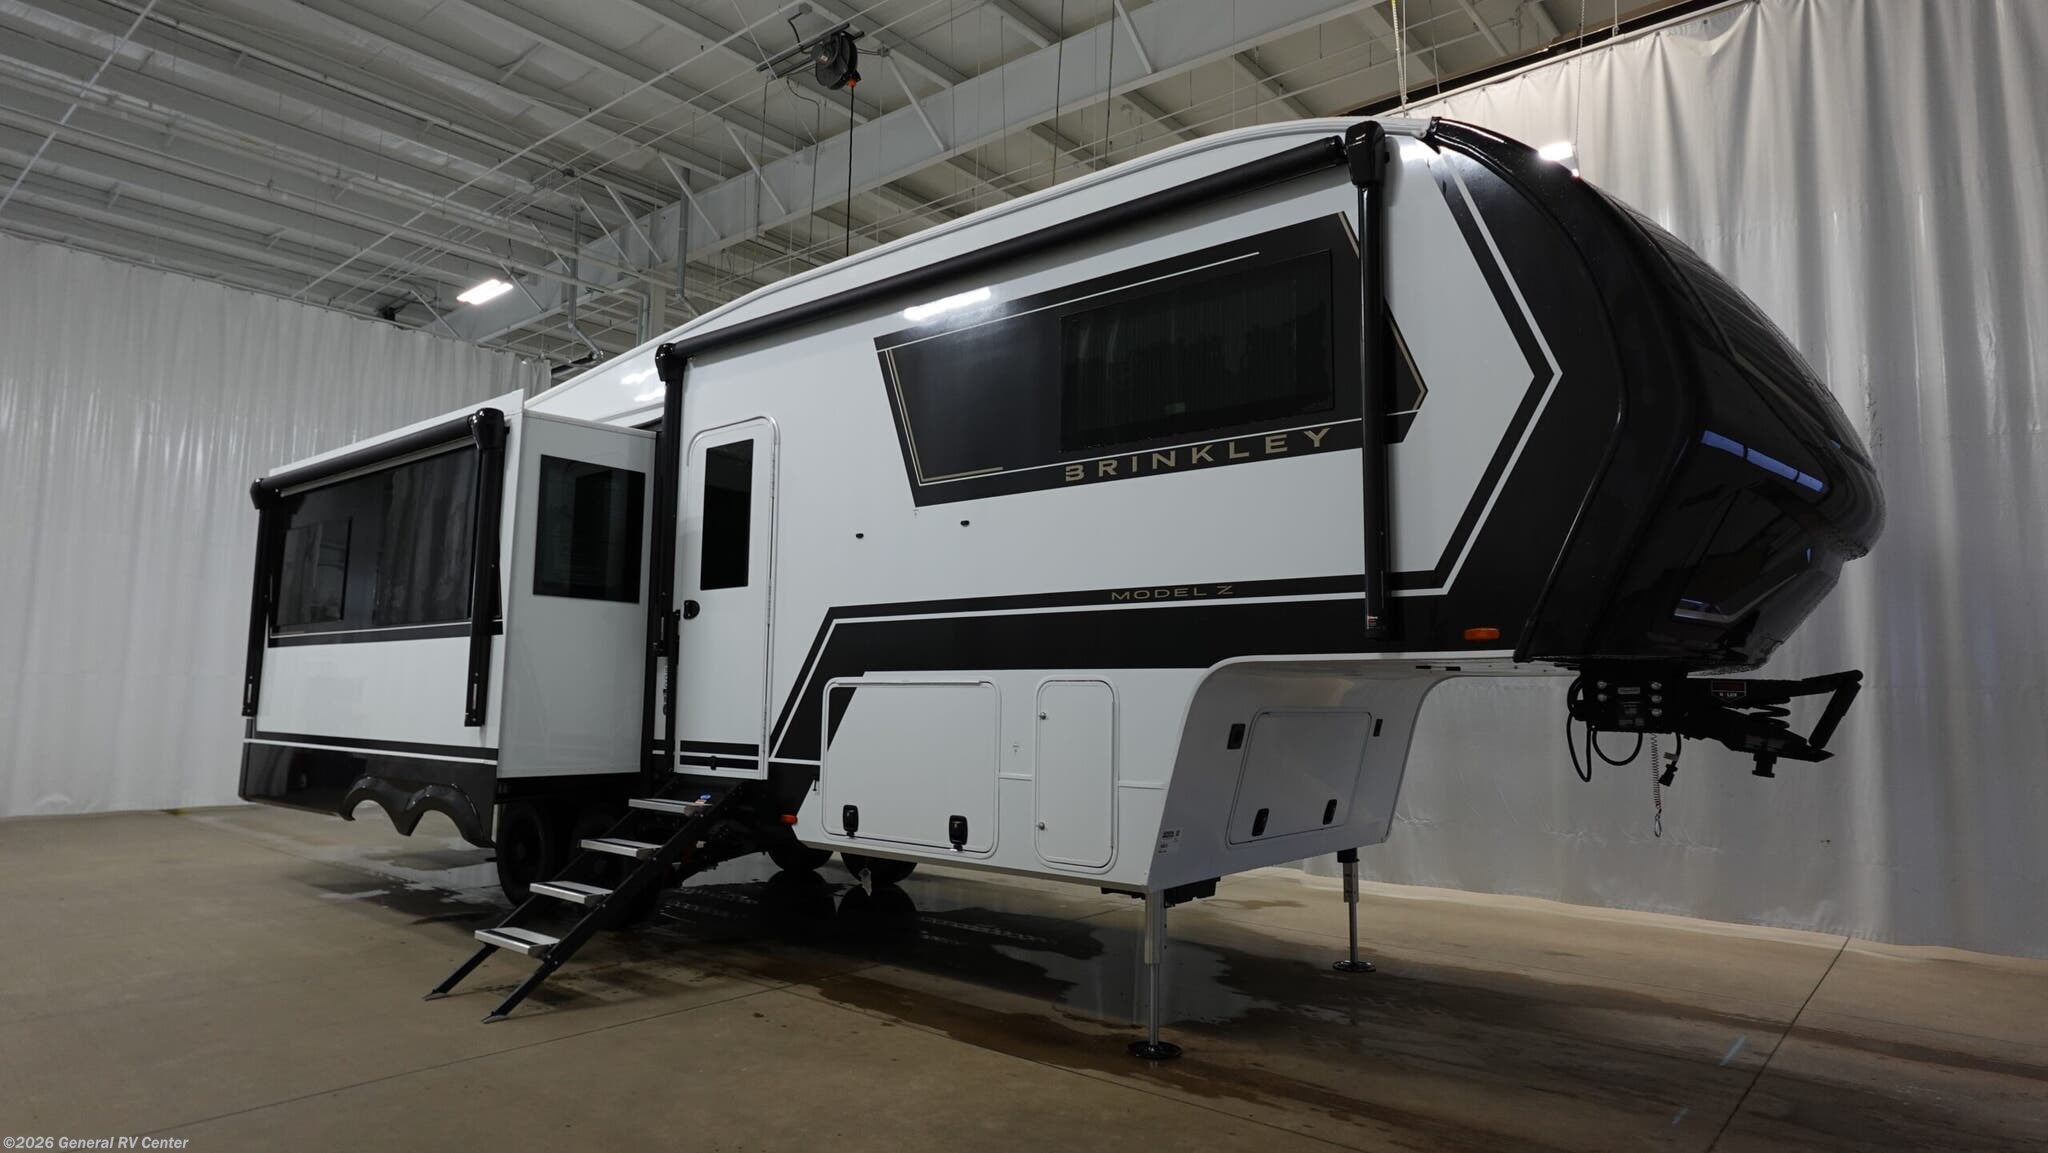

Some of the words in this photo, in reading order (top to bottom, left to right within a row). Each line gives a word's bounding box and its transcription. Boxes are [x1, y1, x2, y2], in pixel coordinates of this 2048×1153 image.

[1065, 427, 1331, 482] BRINKLEY
[1111, 586, 1207, 601] MODEL
[1216, 584, 1234, 596] Z
